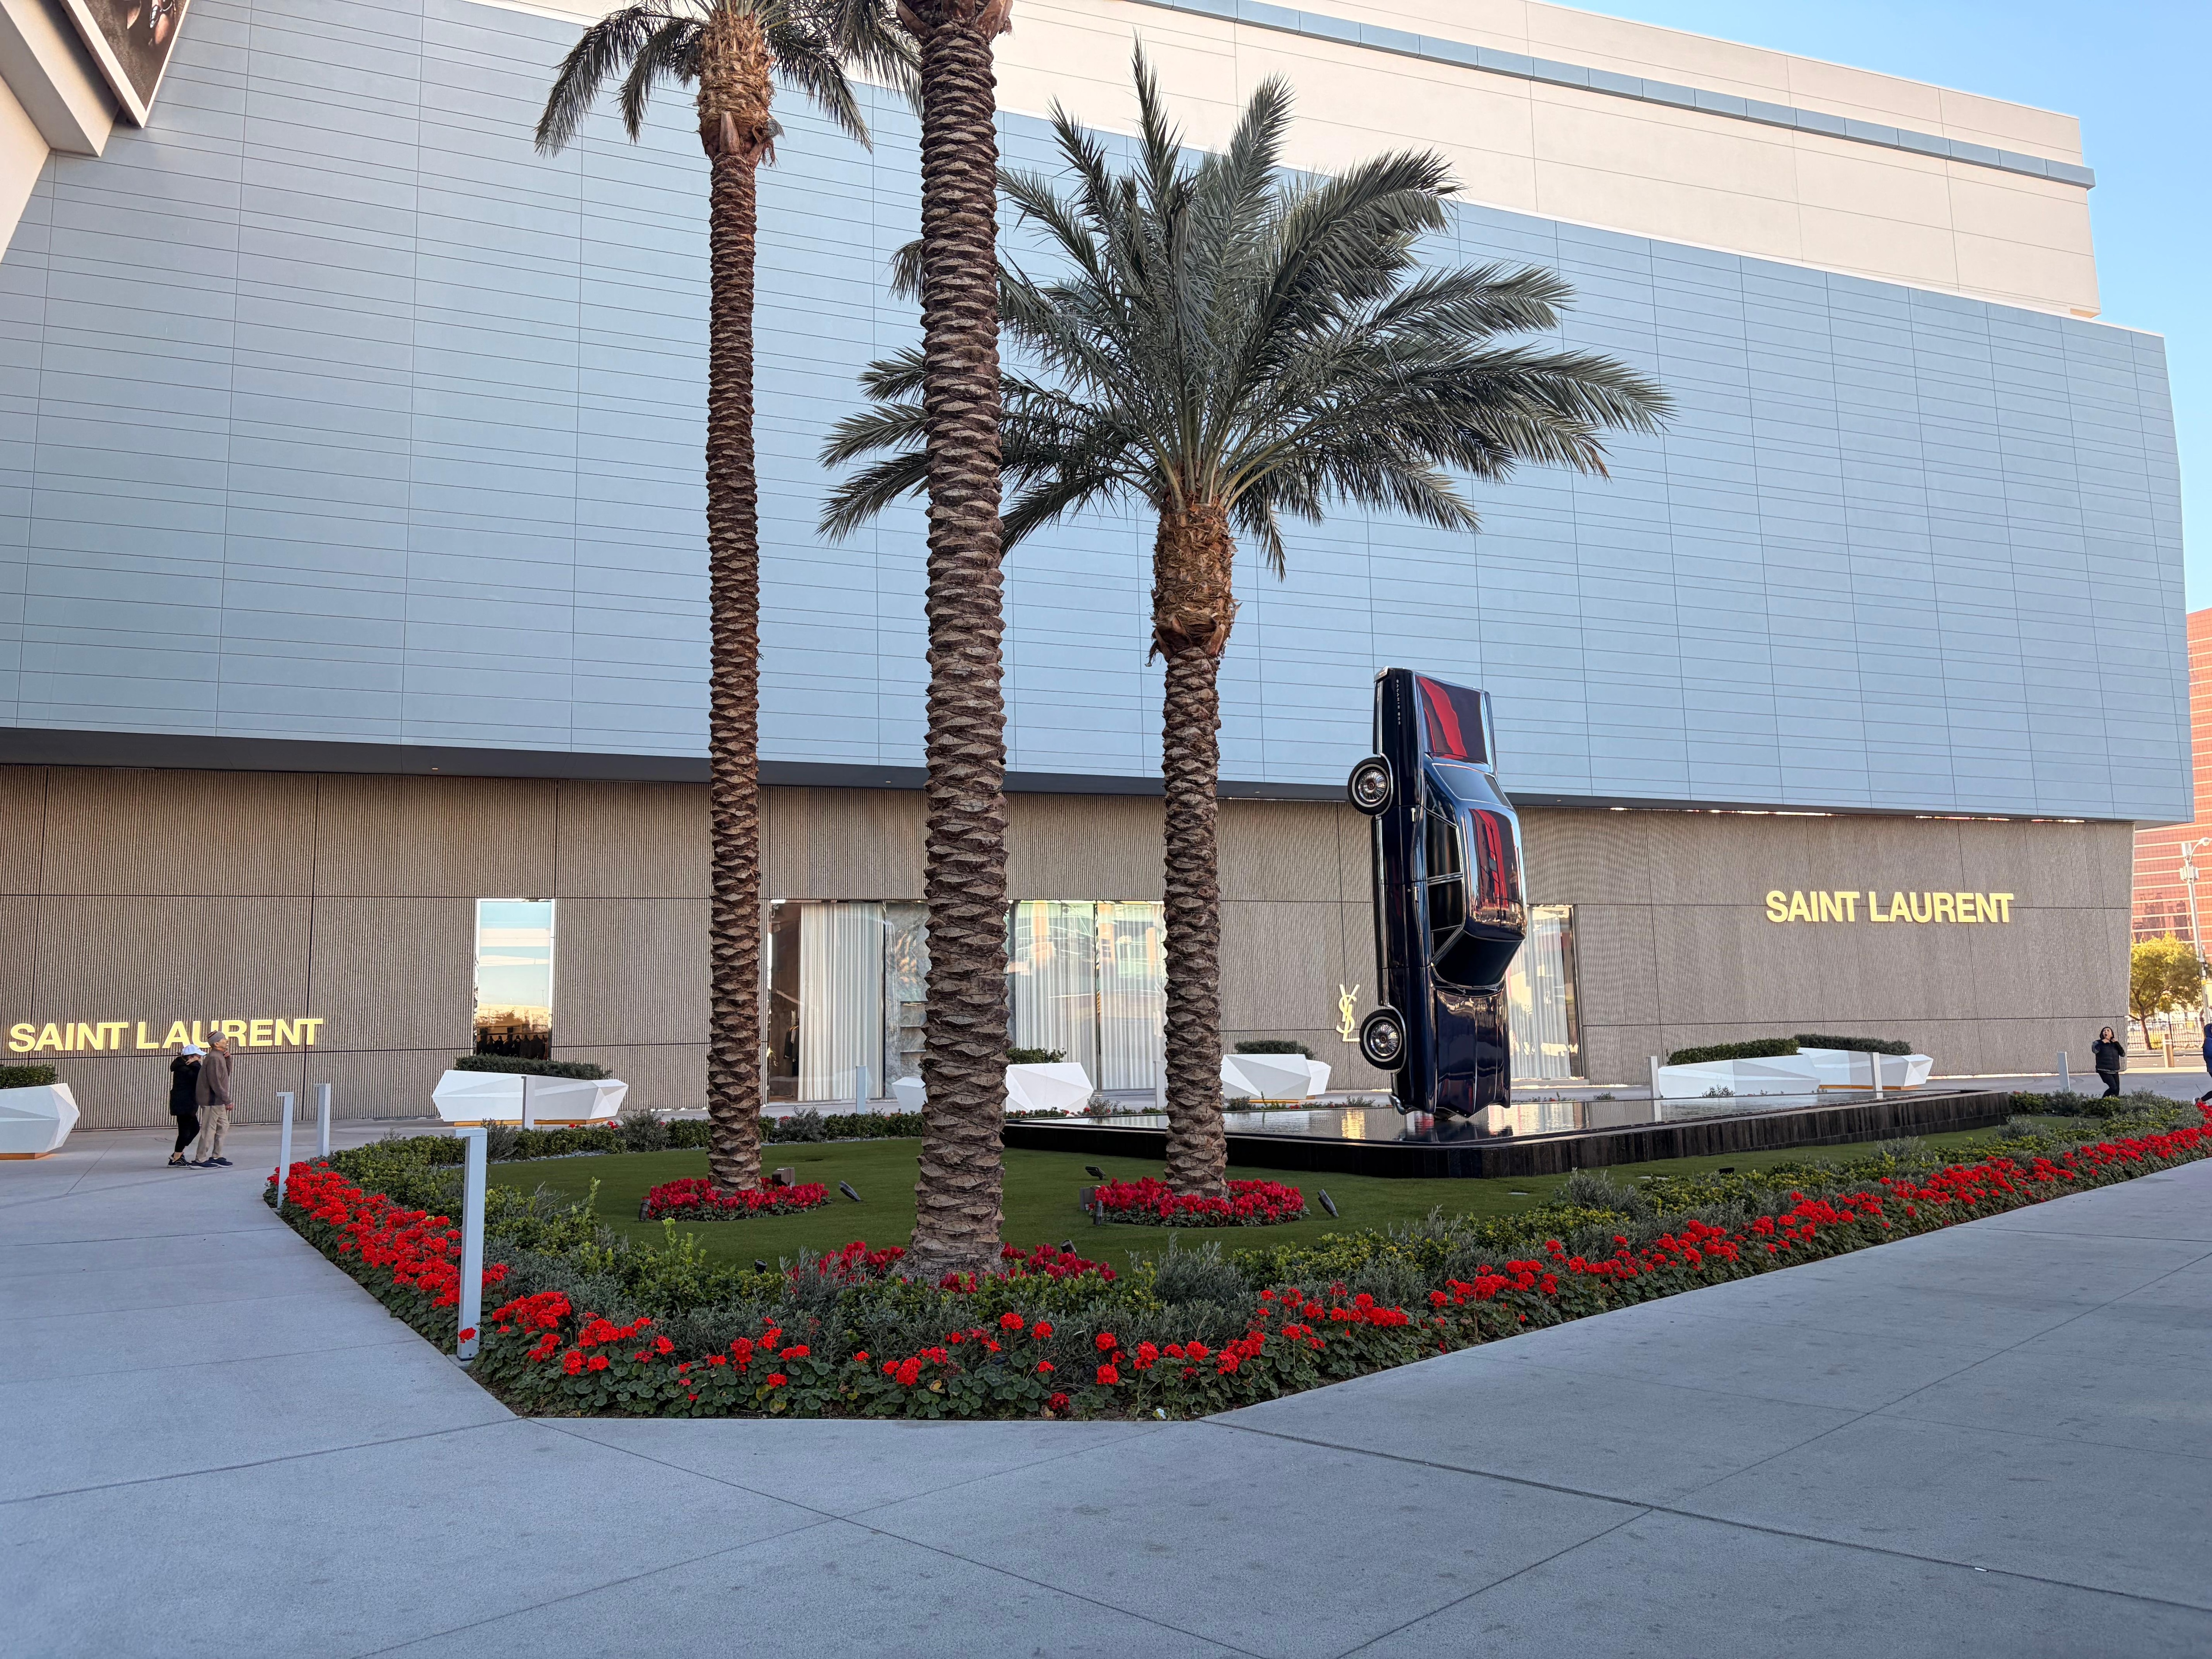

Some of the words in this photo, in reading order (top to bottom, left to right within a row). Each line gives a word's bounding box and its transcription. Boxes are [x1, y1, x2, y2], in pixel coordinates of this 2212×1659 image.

[1766, 890, 1860, 923] SAINT
[1869, 891, 2014, 923] LAURENT
[1336, 984, 1360, 1042] YSL
[8, 1022, 129, 1052] SAINT
[136, 1018, 323, 1049] LAURENT
